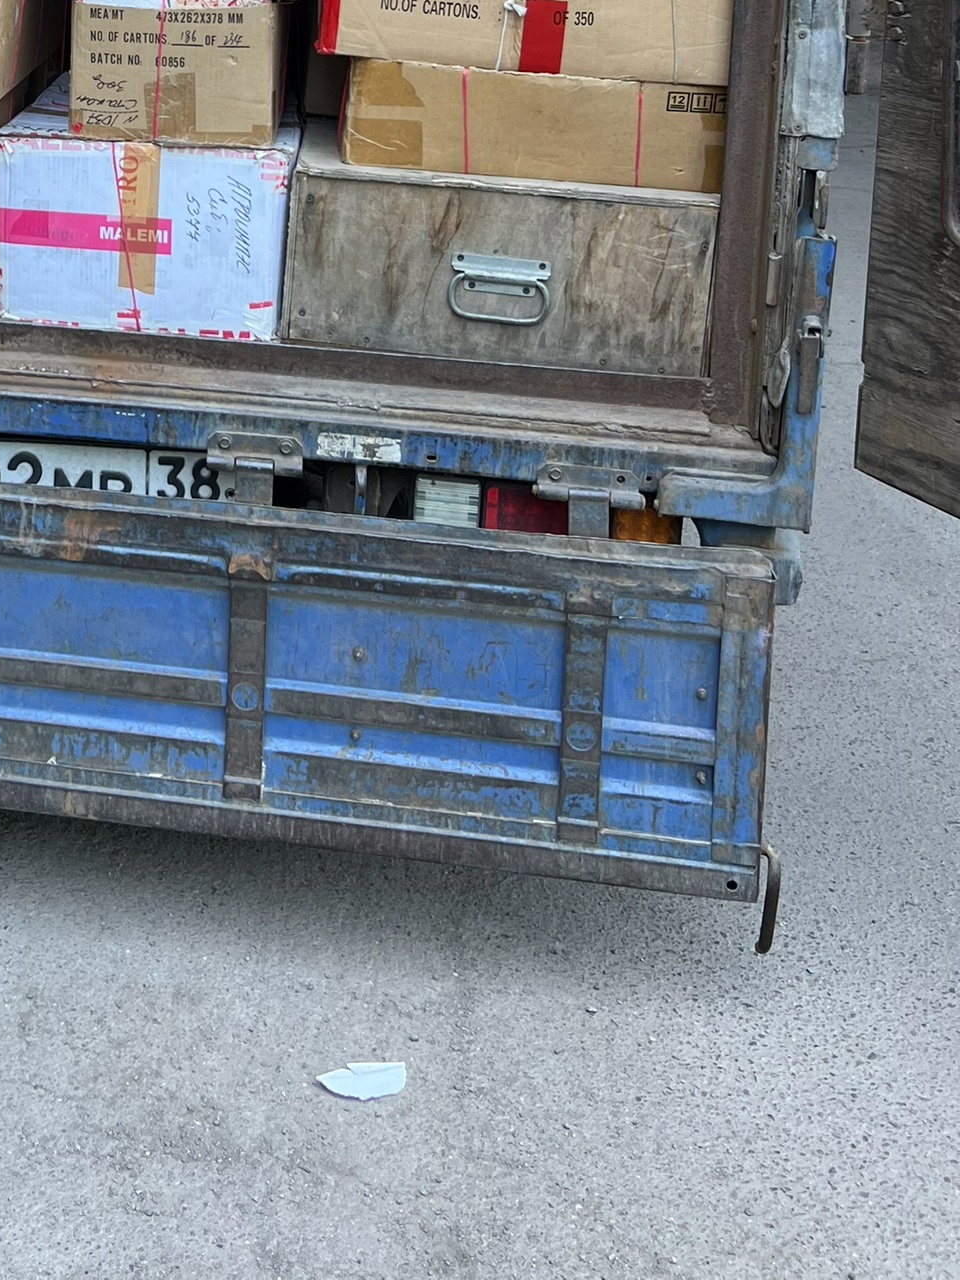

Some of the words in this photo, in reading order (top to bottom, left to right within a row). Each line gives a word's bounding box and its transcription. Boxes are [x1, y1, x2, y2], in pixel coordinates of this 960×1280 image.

[228, 13, 244, 25] MM
[422, 0, 482, 20] CARTONS.
[553, 10, 569, 26] OF
[574, 11, 594, 26] 350
[90, 30, 105, 42] NO.
[108, 31, 119, 43] OF
[205, 35, 217, 46] OF
[90, 53, 123, 65] BATCH
[671, 93, 686, 105] 12
[99, 225, 168, 244] MALEMI
[156, 455, 220, 500] 38
